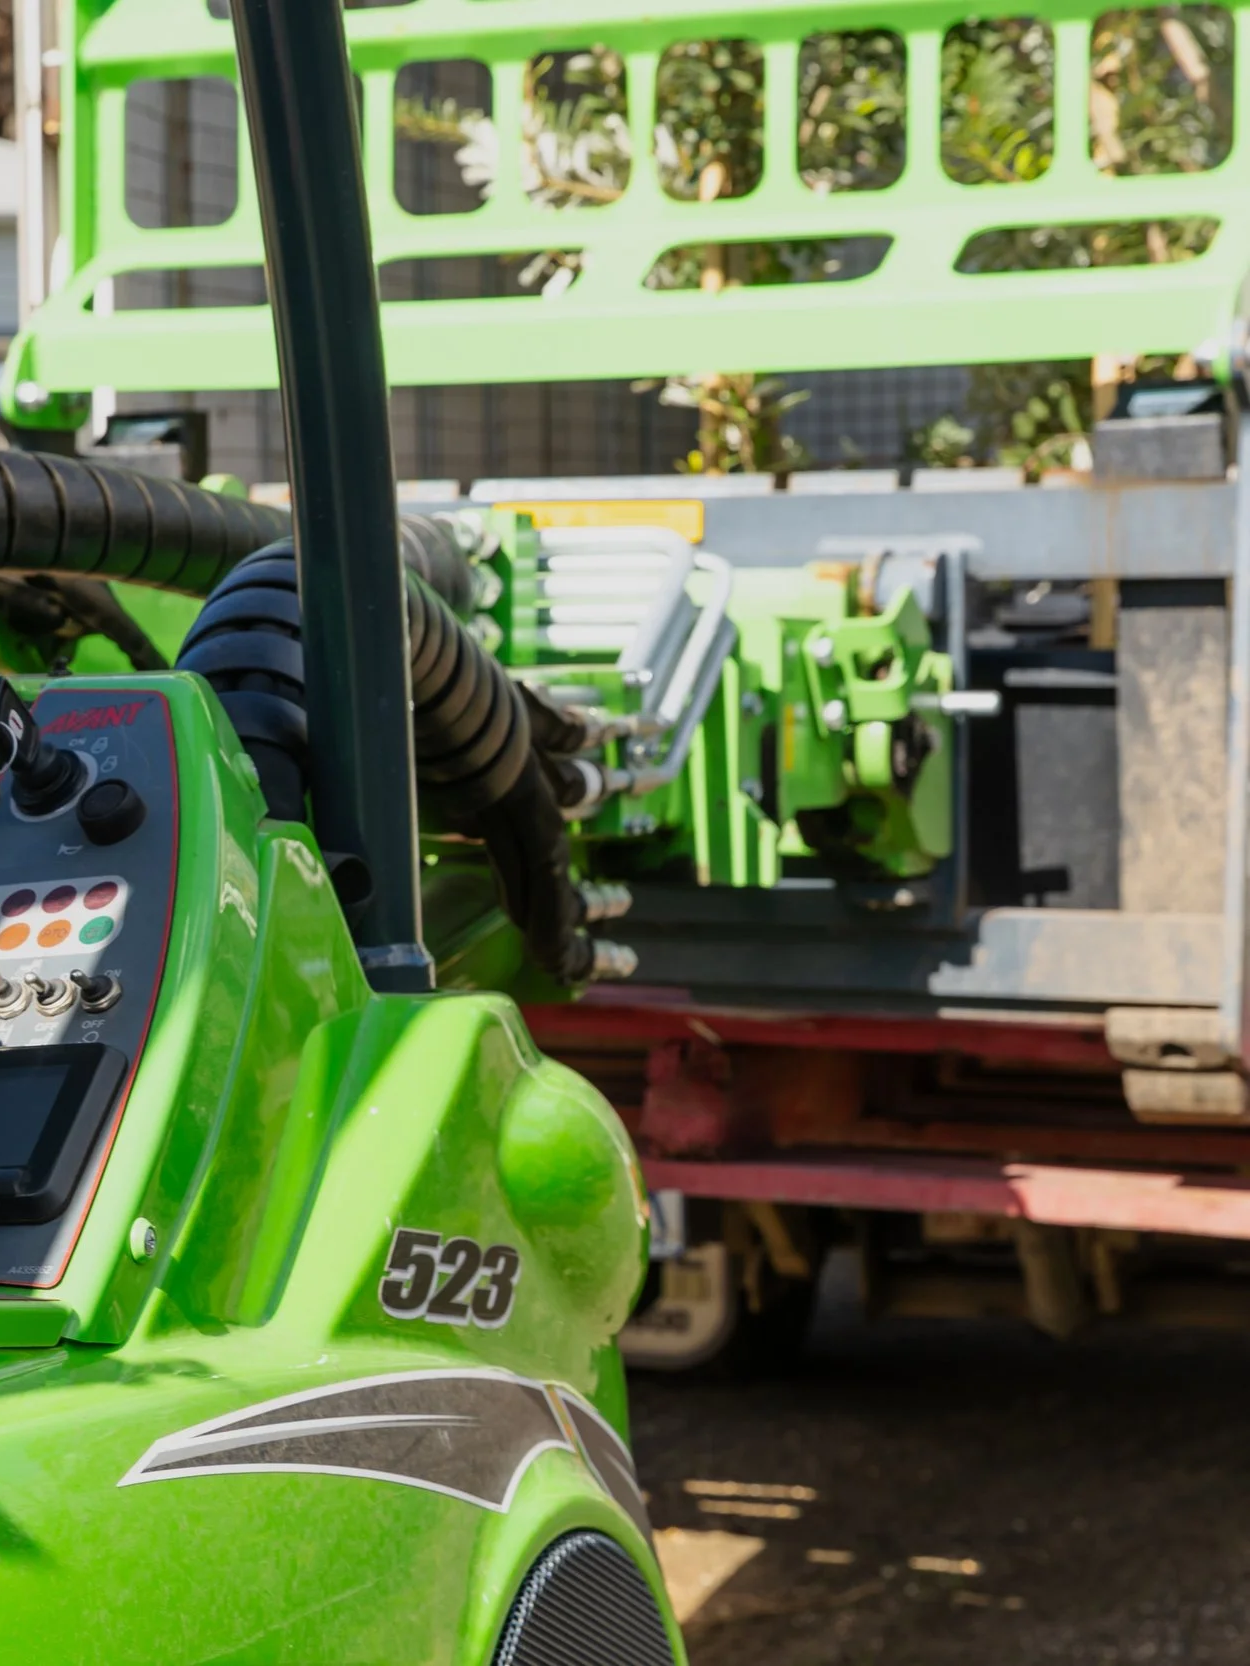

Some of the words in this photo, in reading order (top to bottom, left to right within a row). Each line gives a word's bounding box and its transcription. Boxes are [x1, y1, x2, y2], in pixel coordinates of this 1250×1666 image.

[40, 702, 146, 735] AVANT
[81, 1020, 106, 1032] OFF
[378, 1227, 521, 1330] 523
